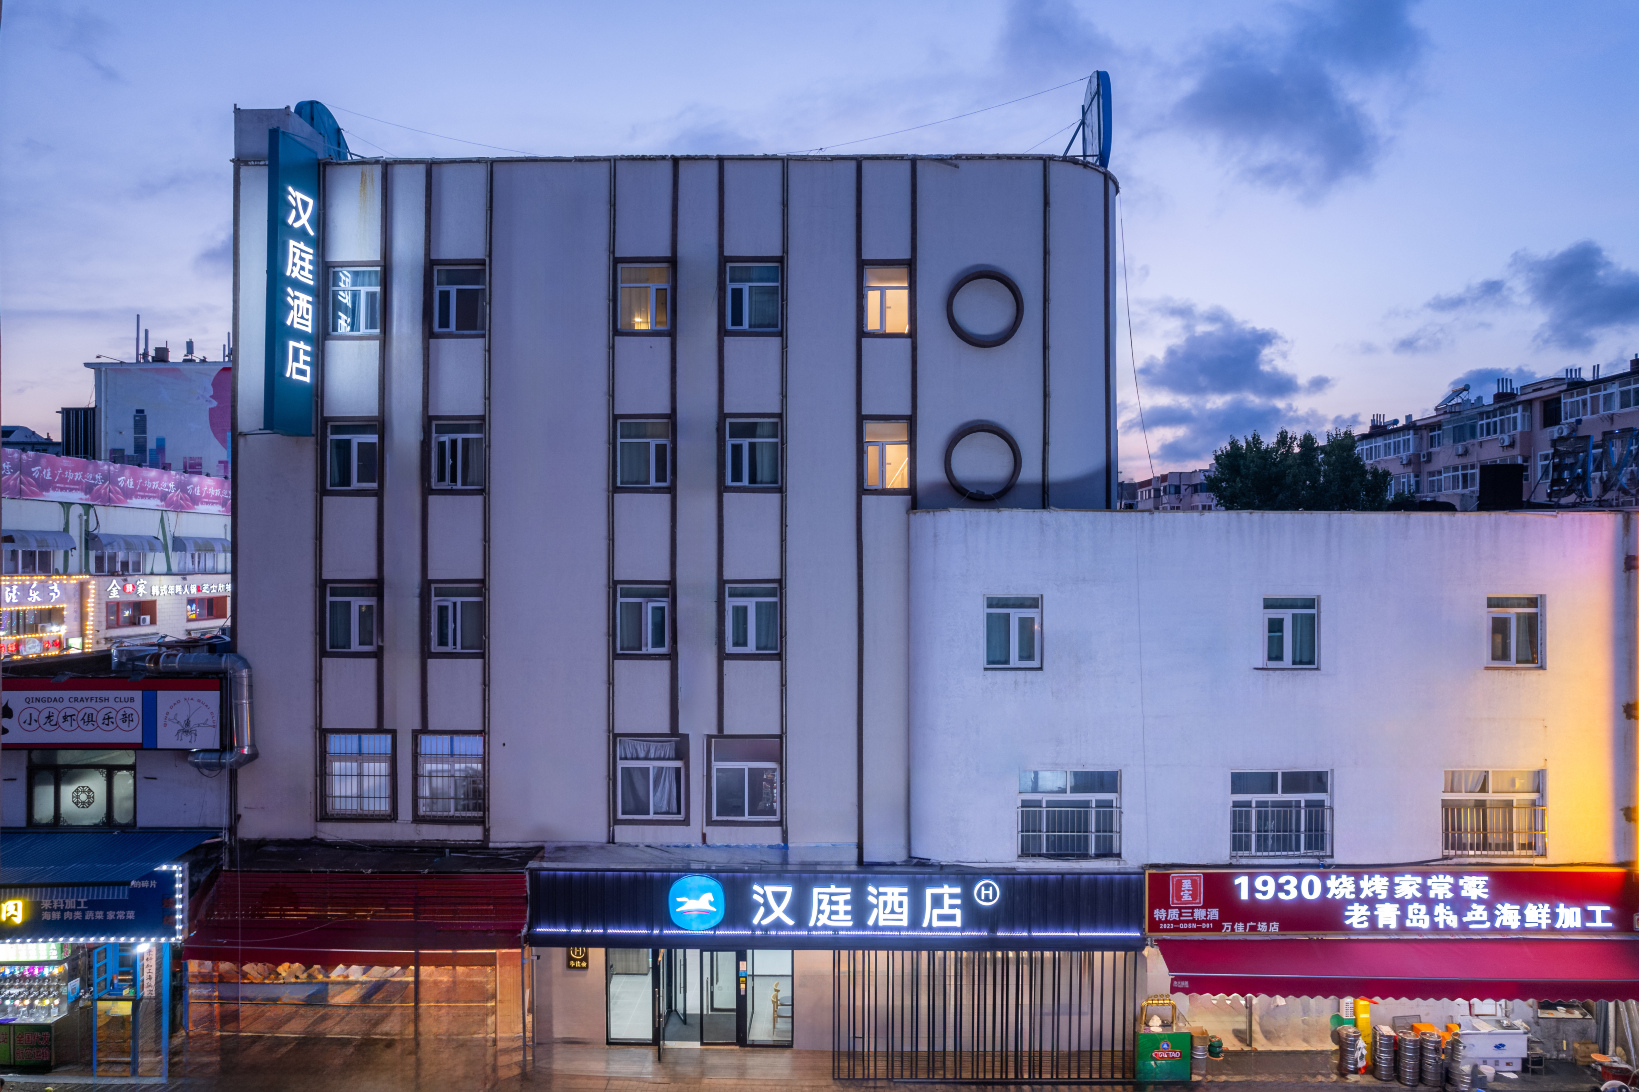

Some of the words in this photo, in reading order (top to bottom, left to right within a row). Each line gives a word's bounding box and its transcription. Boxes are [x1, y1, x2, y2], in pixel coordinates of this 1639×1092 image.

[285, 185, 315, 383] 汉庭酒店
[24, 696, 64, 704] QINGDAO
[22, 710, 134, 728] 小龙虾俱乐部
[1180, 879, 1193, 901] 至宝
[1234, 874, 1489, 899] 1930烧烤家常菜
[40, 898, 89, 910] 来料加工
[752, 883, 962, 928] 汉庭酒店
[41, 911, 62, 921] 海鲜
[63, 911, 83, 921] 肉类
[85, 911, 104, 920] 蔬菜
[106, 911, 136, 920] 家常菜
[1153, 908, 1219, 921] 特质三鞭酒
[1344, 902, 1613, 929] 老青岛特色海鲜加工
[1221, 922, 1280, 932] 万佳广场店
[16, 1031, 50, 1045] 全国代发
[16, 1047, 50, 1060] 航空运输
